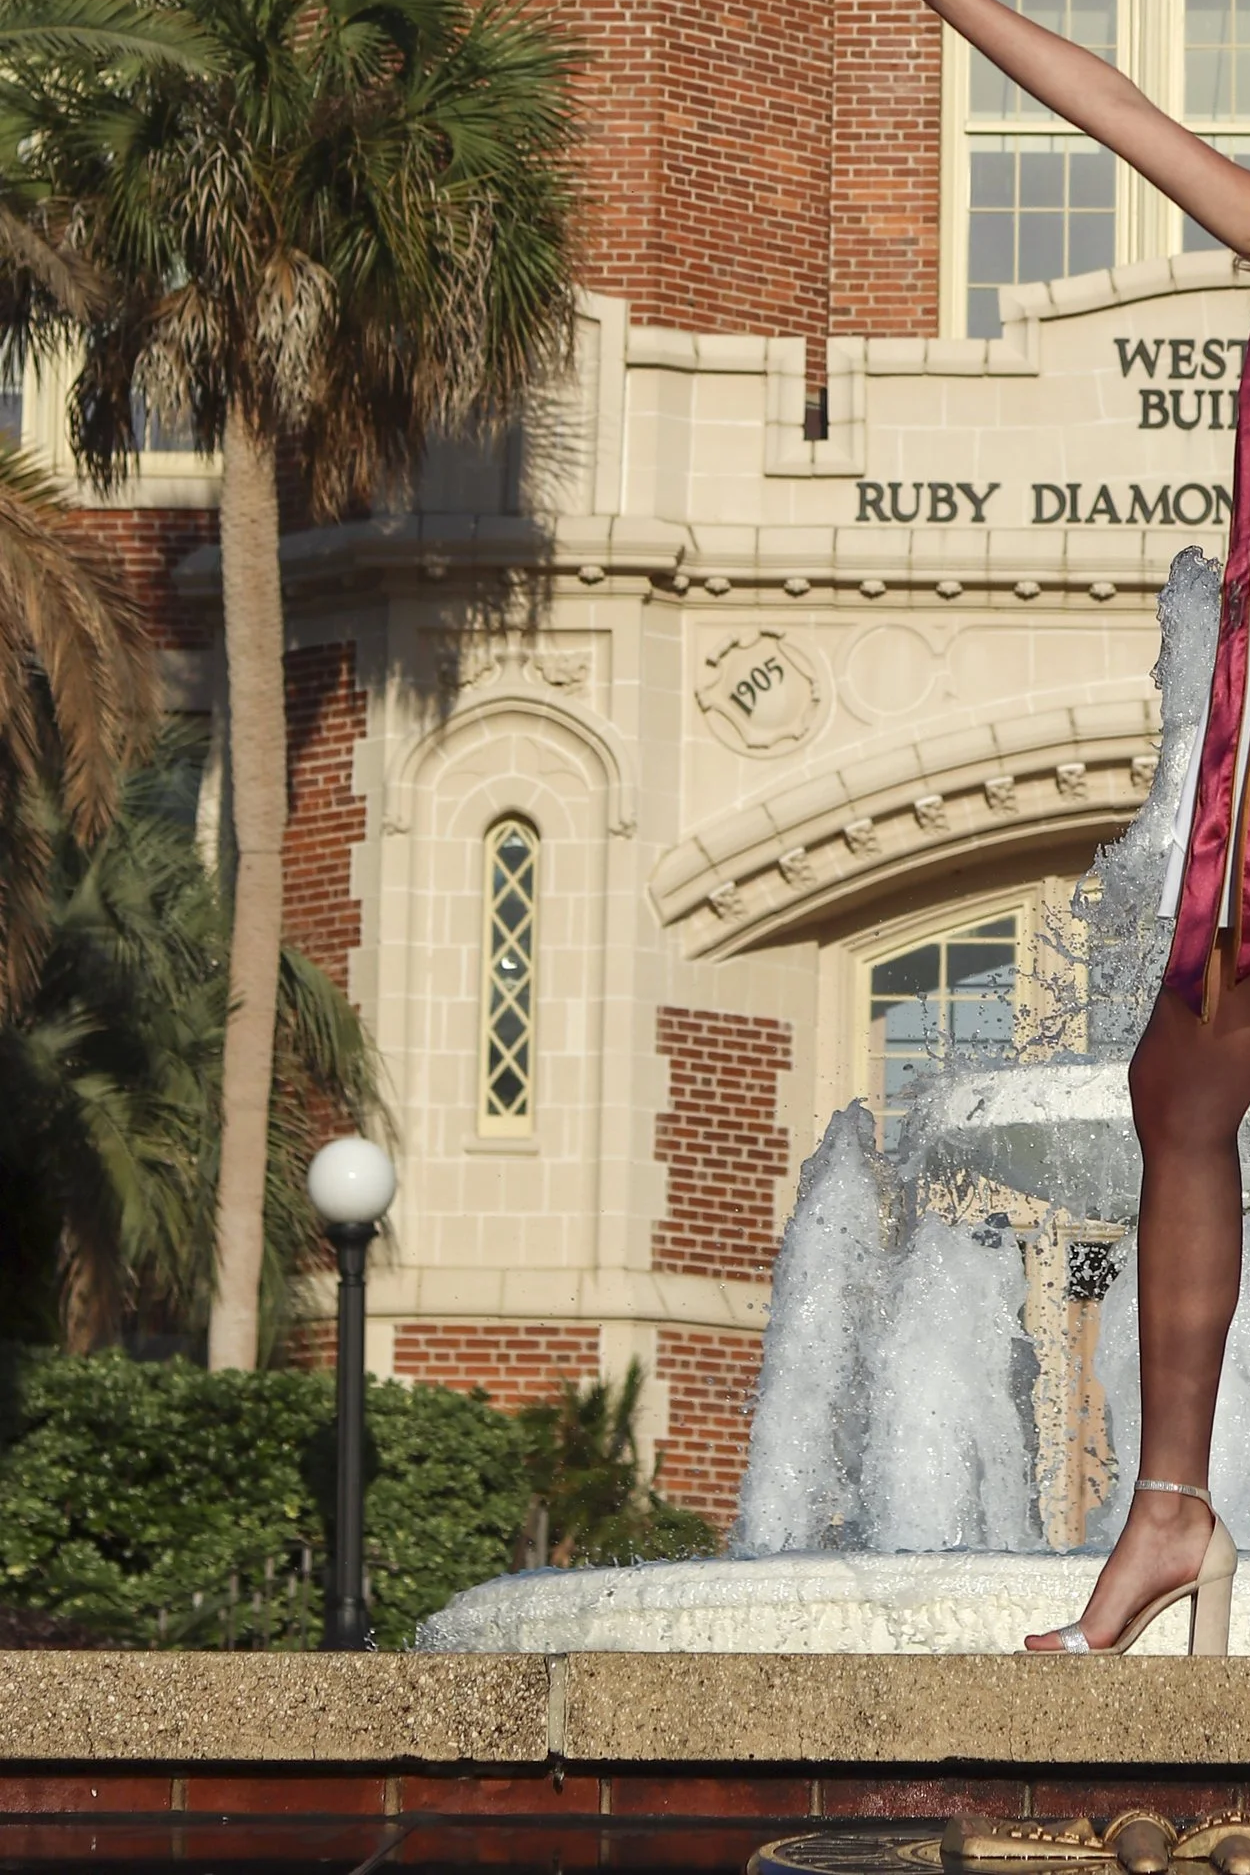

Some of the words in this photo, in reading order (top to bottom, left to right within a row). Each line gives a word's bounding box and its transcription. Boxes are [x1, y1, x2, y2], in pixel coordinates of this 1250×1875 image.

[1113, 338, 1249, 380] WEST
[855, 482, 1001, 523] RUBY
[730, 656, 784, 717] 1905
